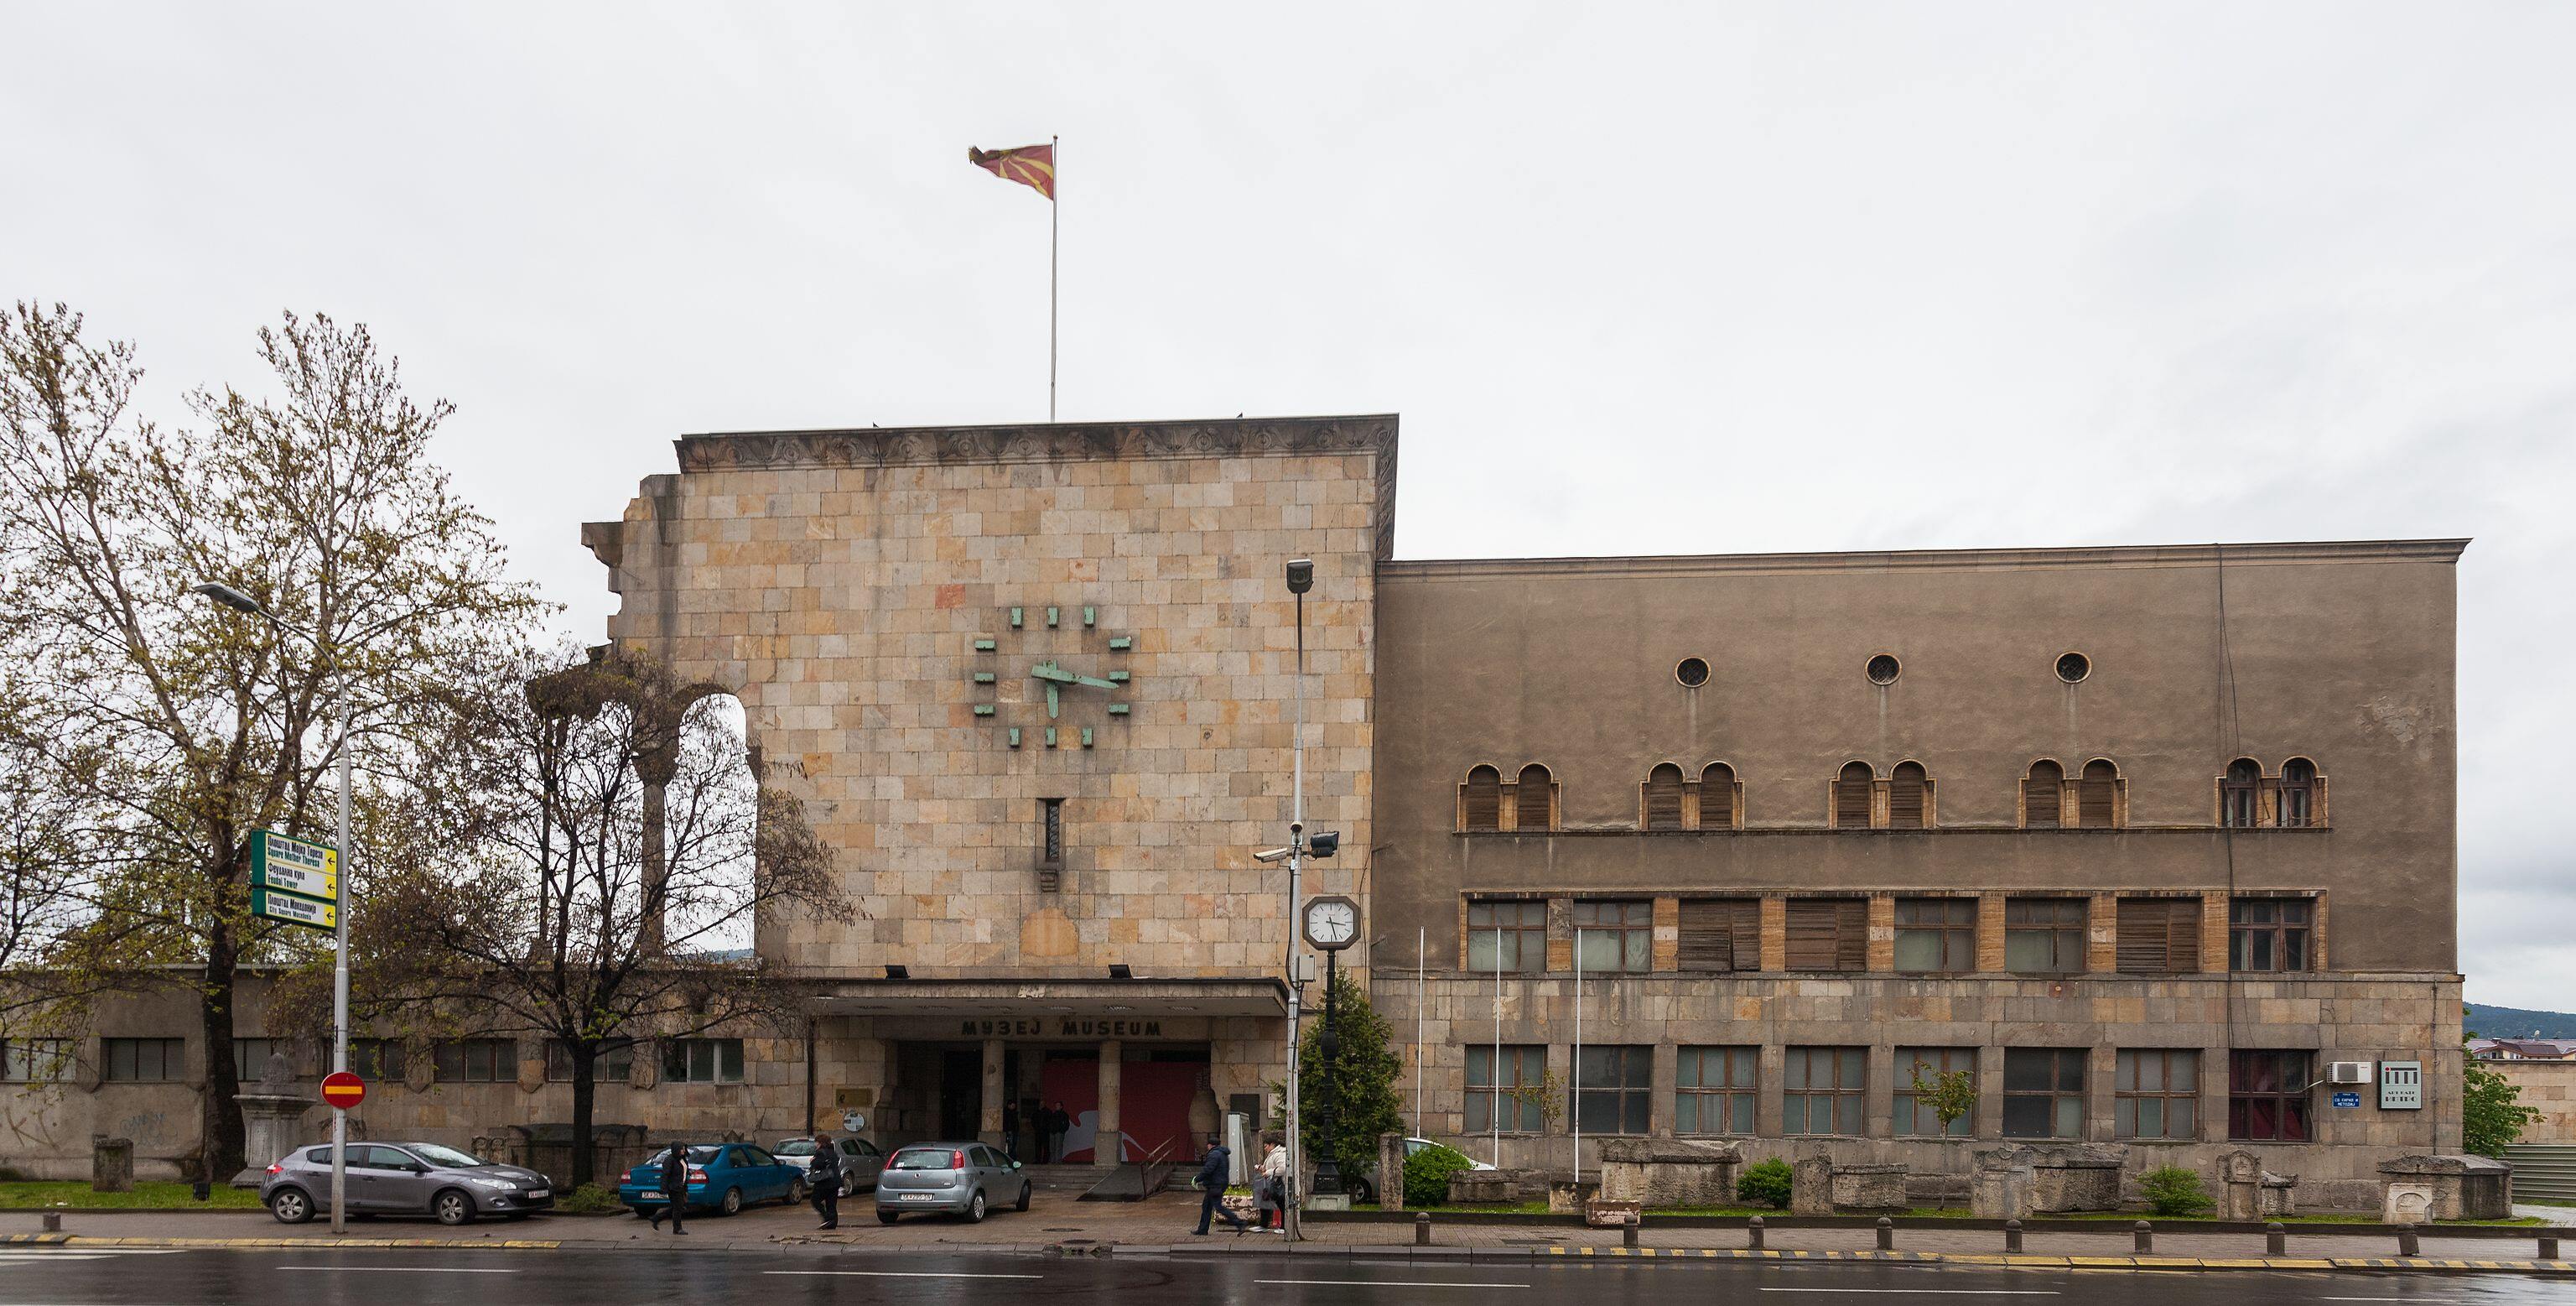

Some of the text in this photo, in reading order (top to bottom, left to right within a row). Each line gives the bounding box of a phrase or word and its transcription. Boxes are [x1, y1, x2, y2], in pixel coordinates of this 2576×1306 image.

[267, 846, 283, 859] Square
[284, 851, 301, 863] Mother
[291, 841, 306, 855] Мајка
[307, 845, 324, 859] Тереза
[267, 874, 299, 889] Feudal Tower
[267, 893, 317, 915] Плоштад Македонија
[961, 1021, 1162, 1036] МУЗЕЈ MUSEUM
